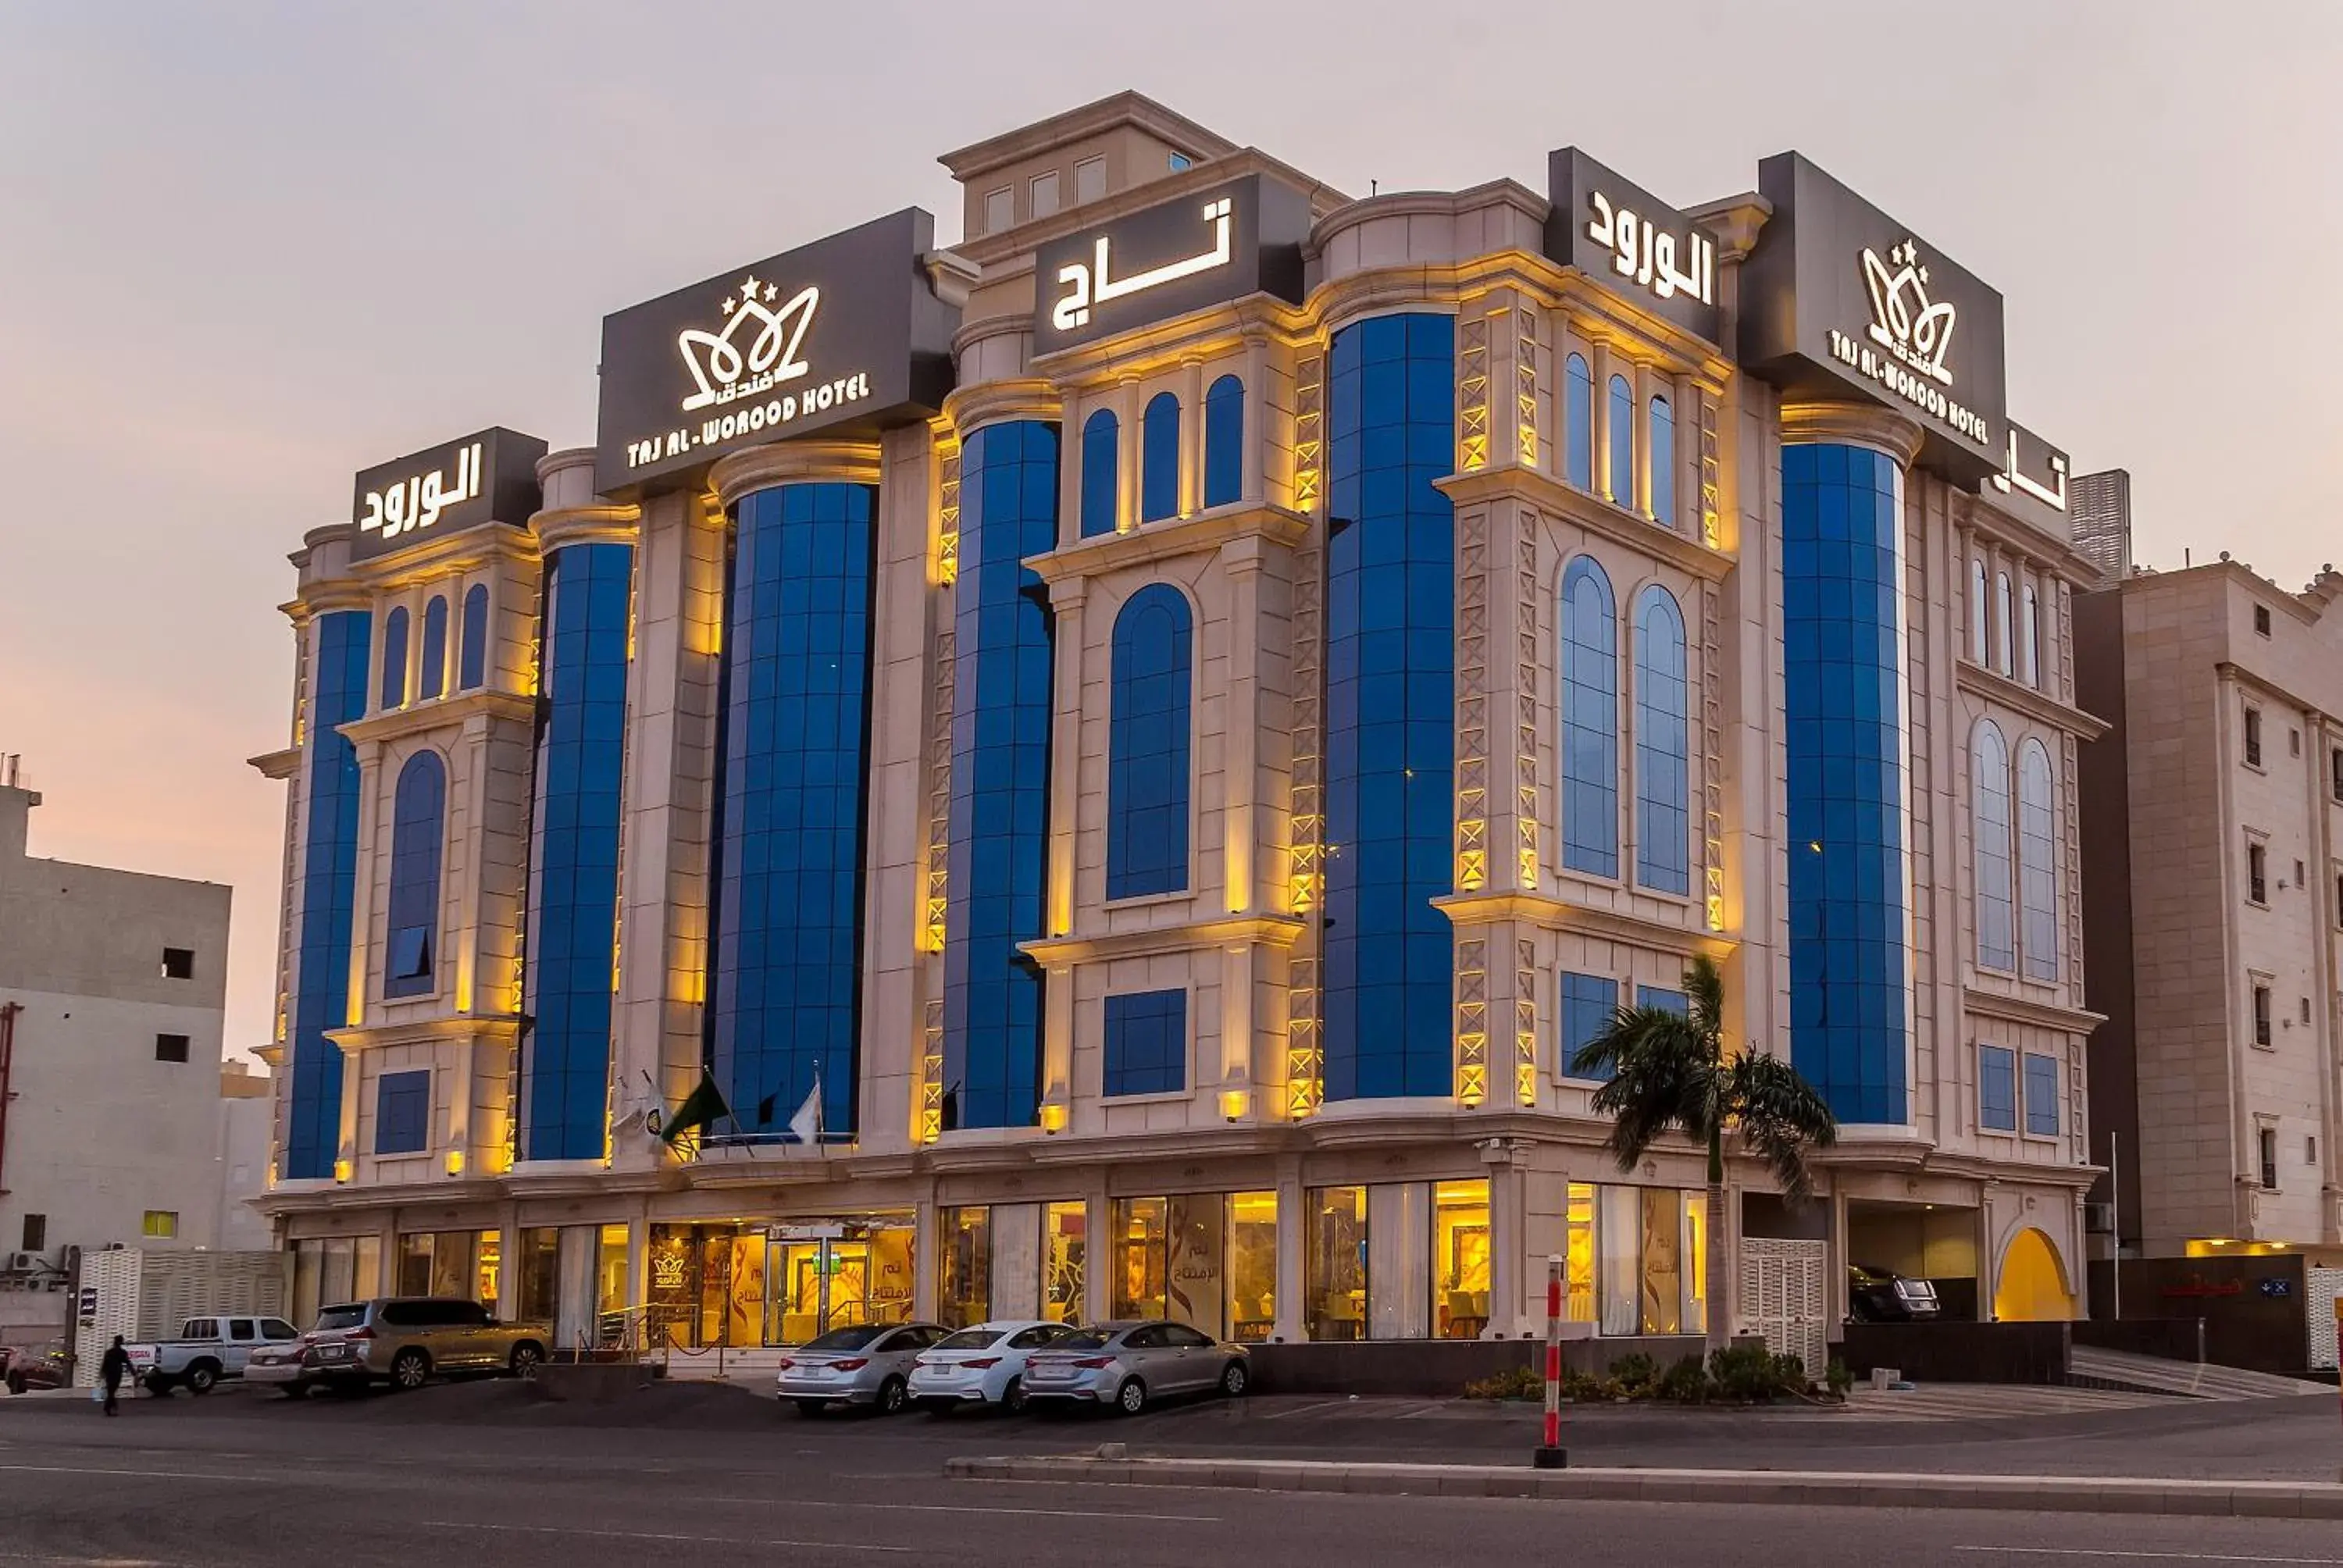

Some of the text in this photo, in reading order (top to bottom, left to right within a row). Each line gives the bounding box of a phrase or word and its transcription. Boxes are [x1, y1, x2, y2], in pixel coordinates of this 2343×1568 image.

[1053, 198, 1231, 330] تاج
[1590, 191, 1712, 305] الورود
[628, 442, 661, 468] TAJ
[803, 372, 869, 415] HOTEL
[1831, 329, 1858, 365] TAJ
[1949, 401, 1988, 444] HOTEL
[360, 442, 482, 539] الورود
